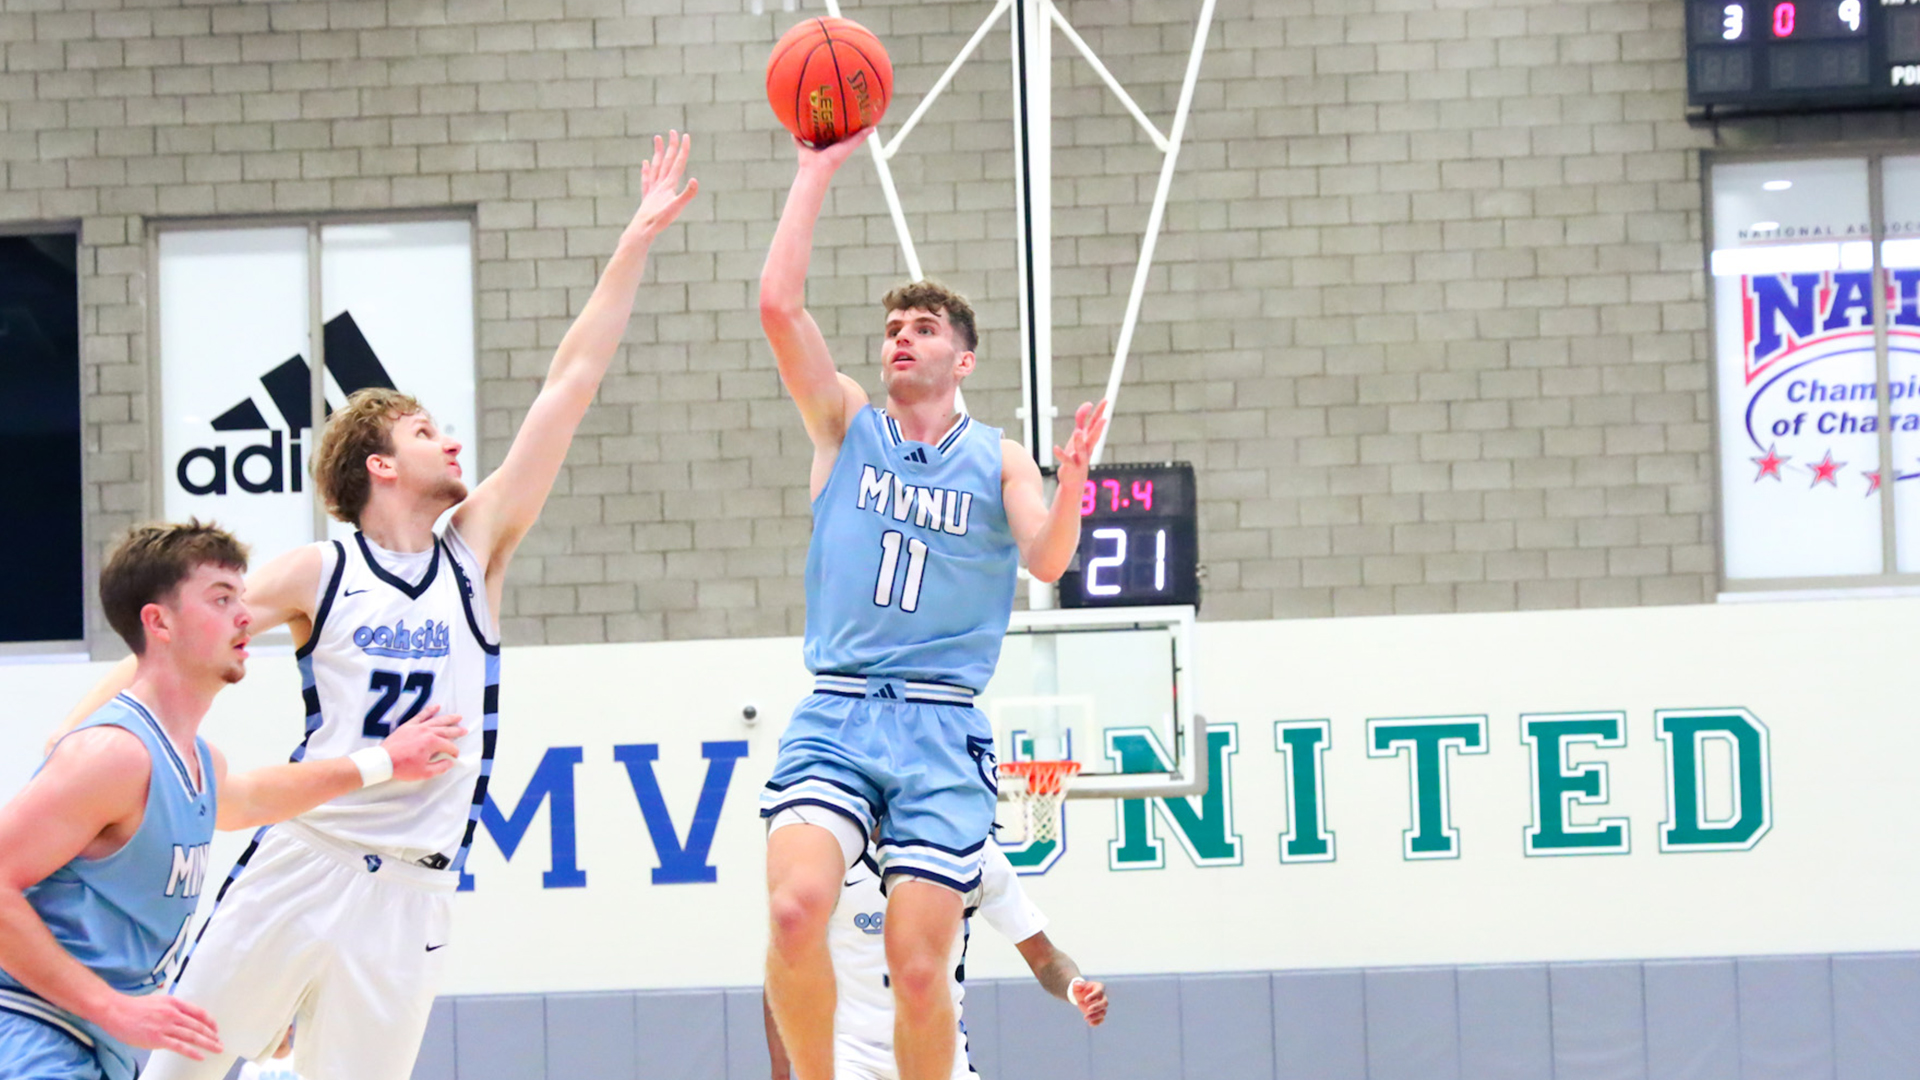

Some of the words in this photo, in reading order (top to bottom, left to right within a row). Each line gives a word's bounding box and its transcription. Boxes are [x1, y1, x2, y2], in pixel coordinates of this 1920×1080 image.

[1722, 4, 1744, 40] 3
[1773, 2, 1796, 38] 0
[1838, 0, 1861, 31] 9
[1771, 411, 1808, 437] of
[856, 463, 974, 537] MVNU
[873, 529, 929, 614] 11
[1086, 528, 1166, 596] 21
